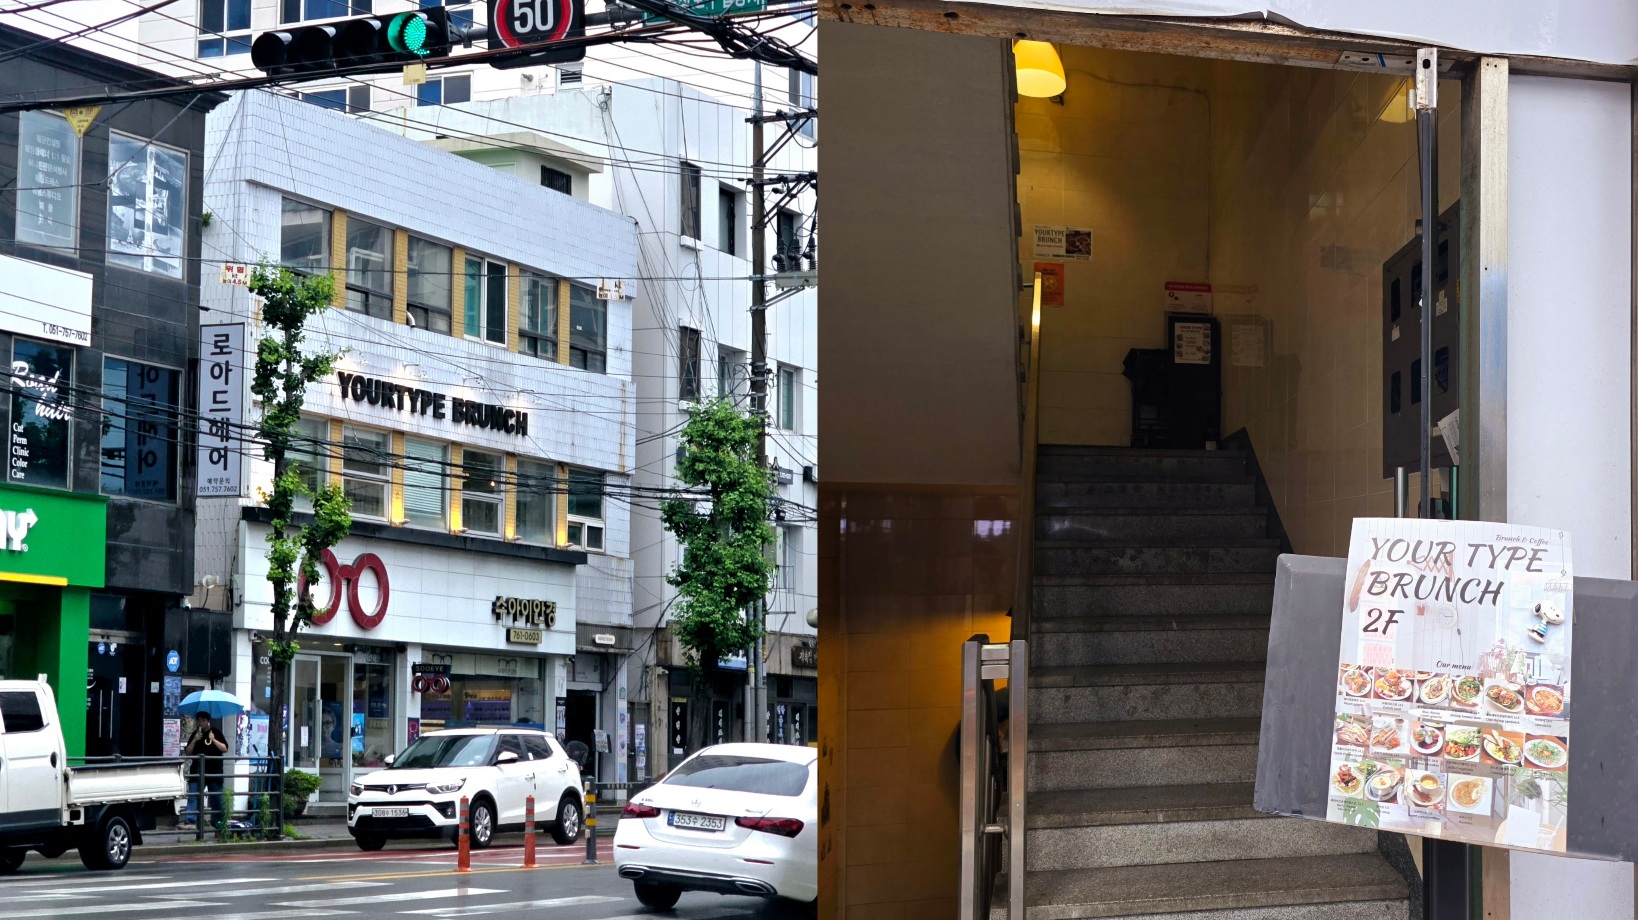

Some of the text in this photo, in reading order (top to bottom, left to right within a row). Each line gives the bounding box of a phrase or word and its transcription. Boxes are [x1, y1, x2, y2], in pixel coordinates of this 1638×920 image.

[513, 0, 554, 34] 50
[1037, 236, 1063, 244] BRUNCH
[208, 332, 233, 472] 로아드헤어
[337, 371, 529, 436] YOURTYPE BRUNCH
[13, 422, 24, 433] Cut
[12, 433, 28, 445] Perm
[12, 445, 30, 457] Clinic
[11, 457, 28, 468] Color
[11, 469, 25, 480] Care
[199, 485, 238, 493] 051.757.7602
[1495, 534, 1521, 543] Brunch
[1529, 537, 1549, 547] Coffee
[1370, 536, 1549, 573] YOUR TYPE
[1365, 570, 1505, 607] BRUNCH
[494, 596, 557, 627] 수아이안경
[1362, 607, 1406, 636] 2F
[1451, 663, 1472, 671] menu
[674, 813, 723, 829] 353수 2353
